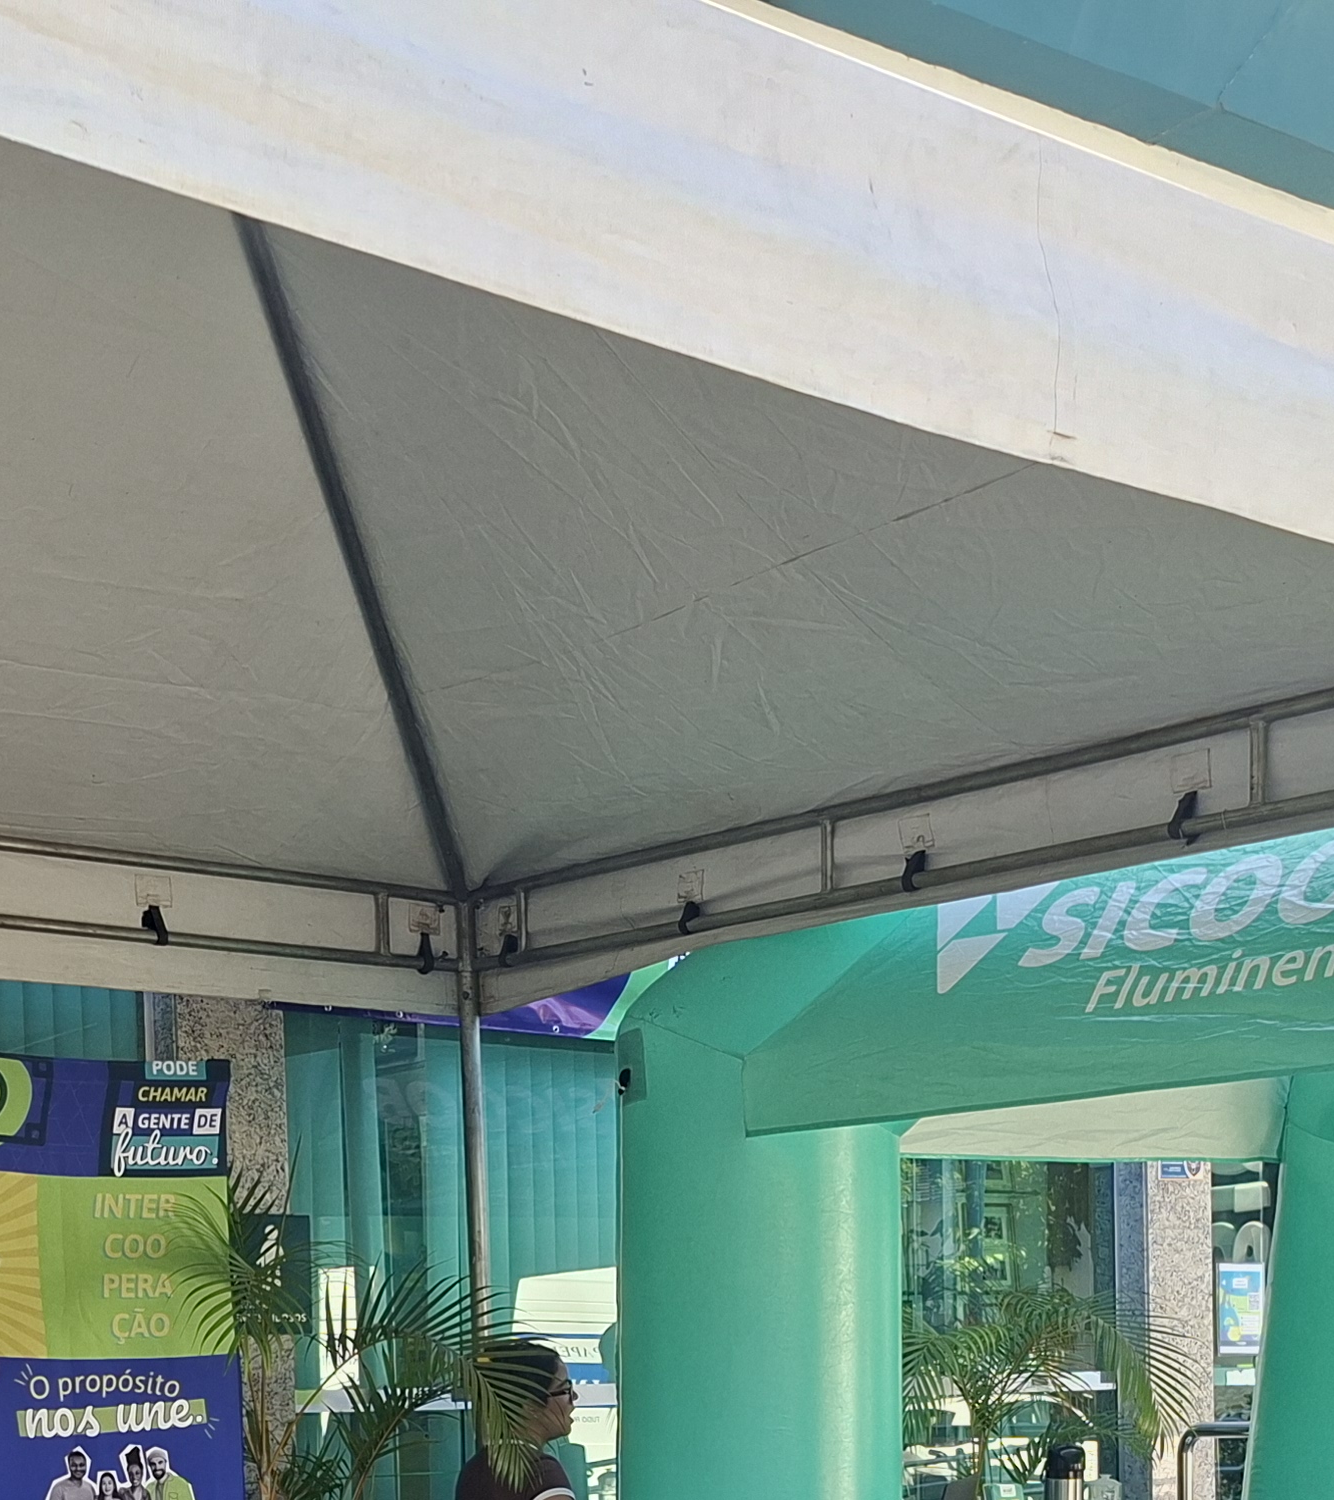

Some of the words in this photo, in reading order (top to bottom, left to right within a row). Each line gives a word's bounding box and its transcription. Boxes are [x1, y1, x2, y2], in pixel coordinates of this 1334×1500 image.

[152, 1061, 199, 1076] PODE
[137, 1086, 208, 1103] CHAMAR
[116, 1113, 131, 1129] A
[137, 1113, 191, 1130] GENTE
[196, 1113, 219, 1129] DE
[113, 1128, 220, 1178] futuro.
[93, 1192, 177, 1219] INTER
[103, 1233, 167, 1260] COO
[102, 1272, 175, 1299] PERA
[110, 1307, 171, 1345] ÇÃO
[29, 1374, 50, 1401] O
[58, 1369, 181, 1402] propósito
[24, 1406, 99, 1440] nos
[114, 1397, 206, 1436] une.
